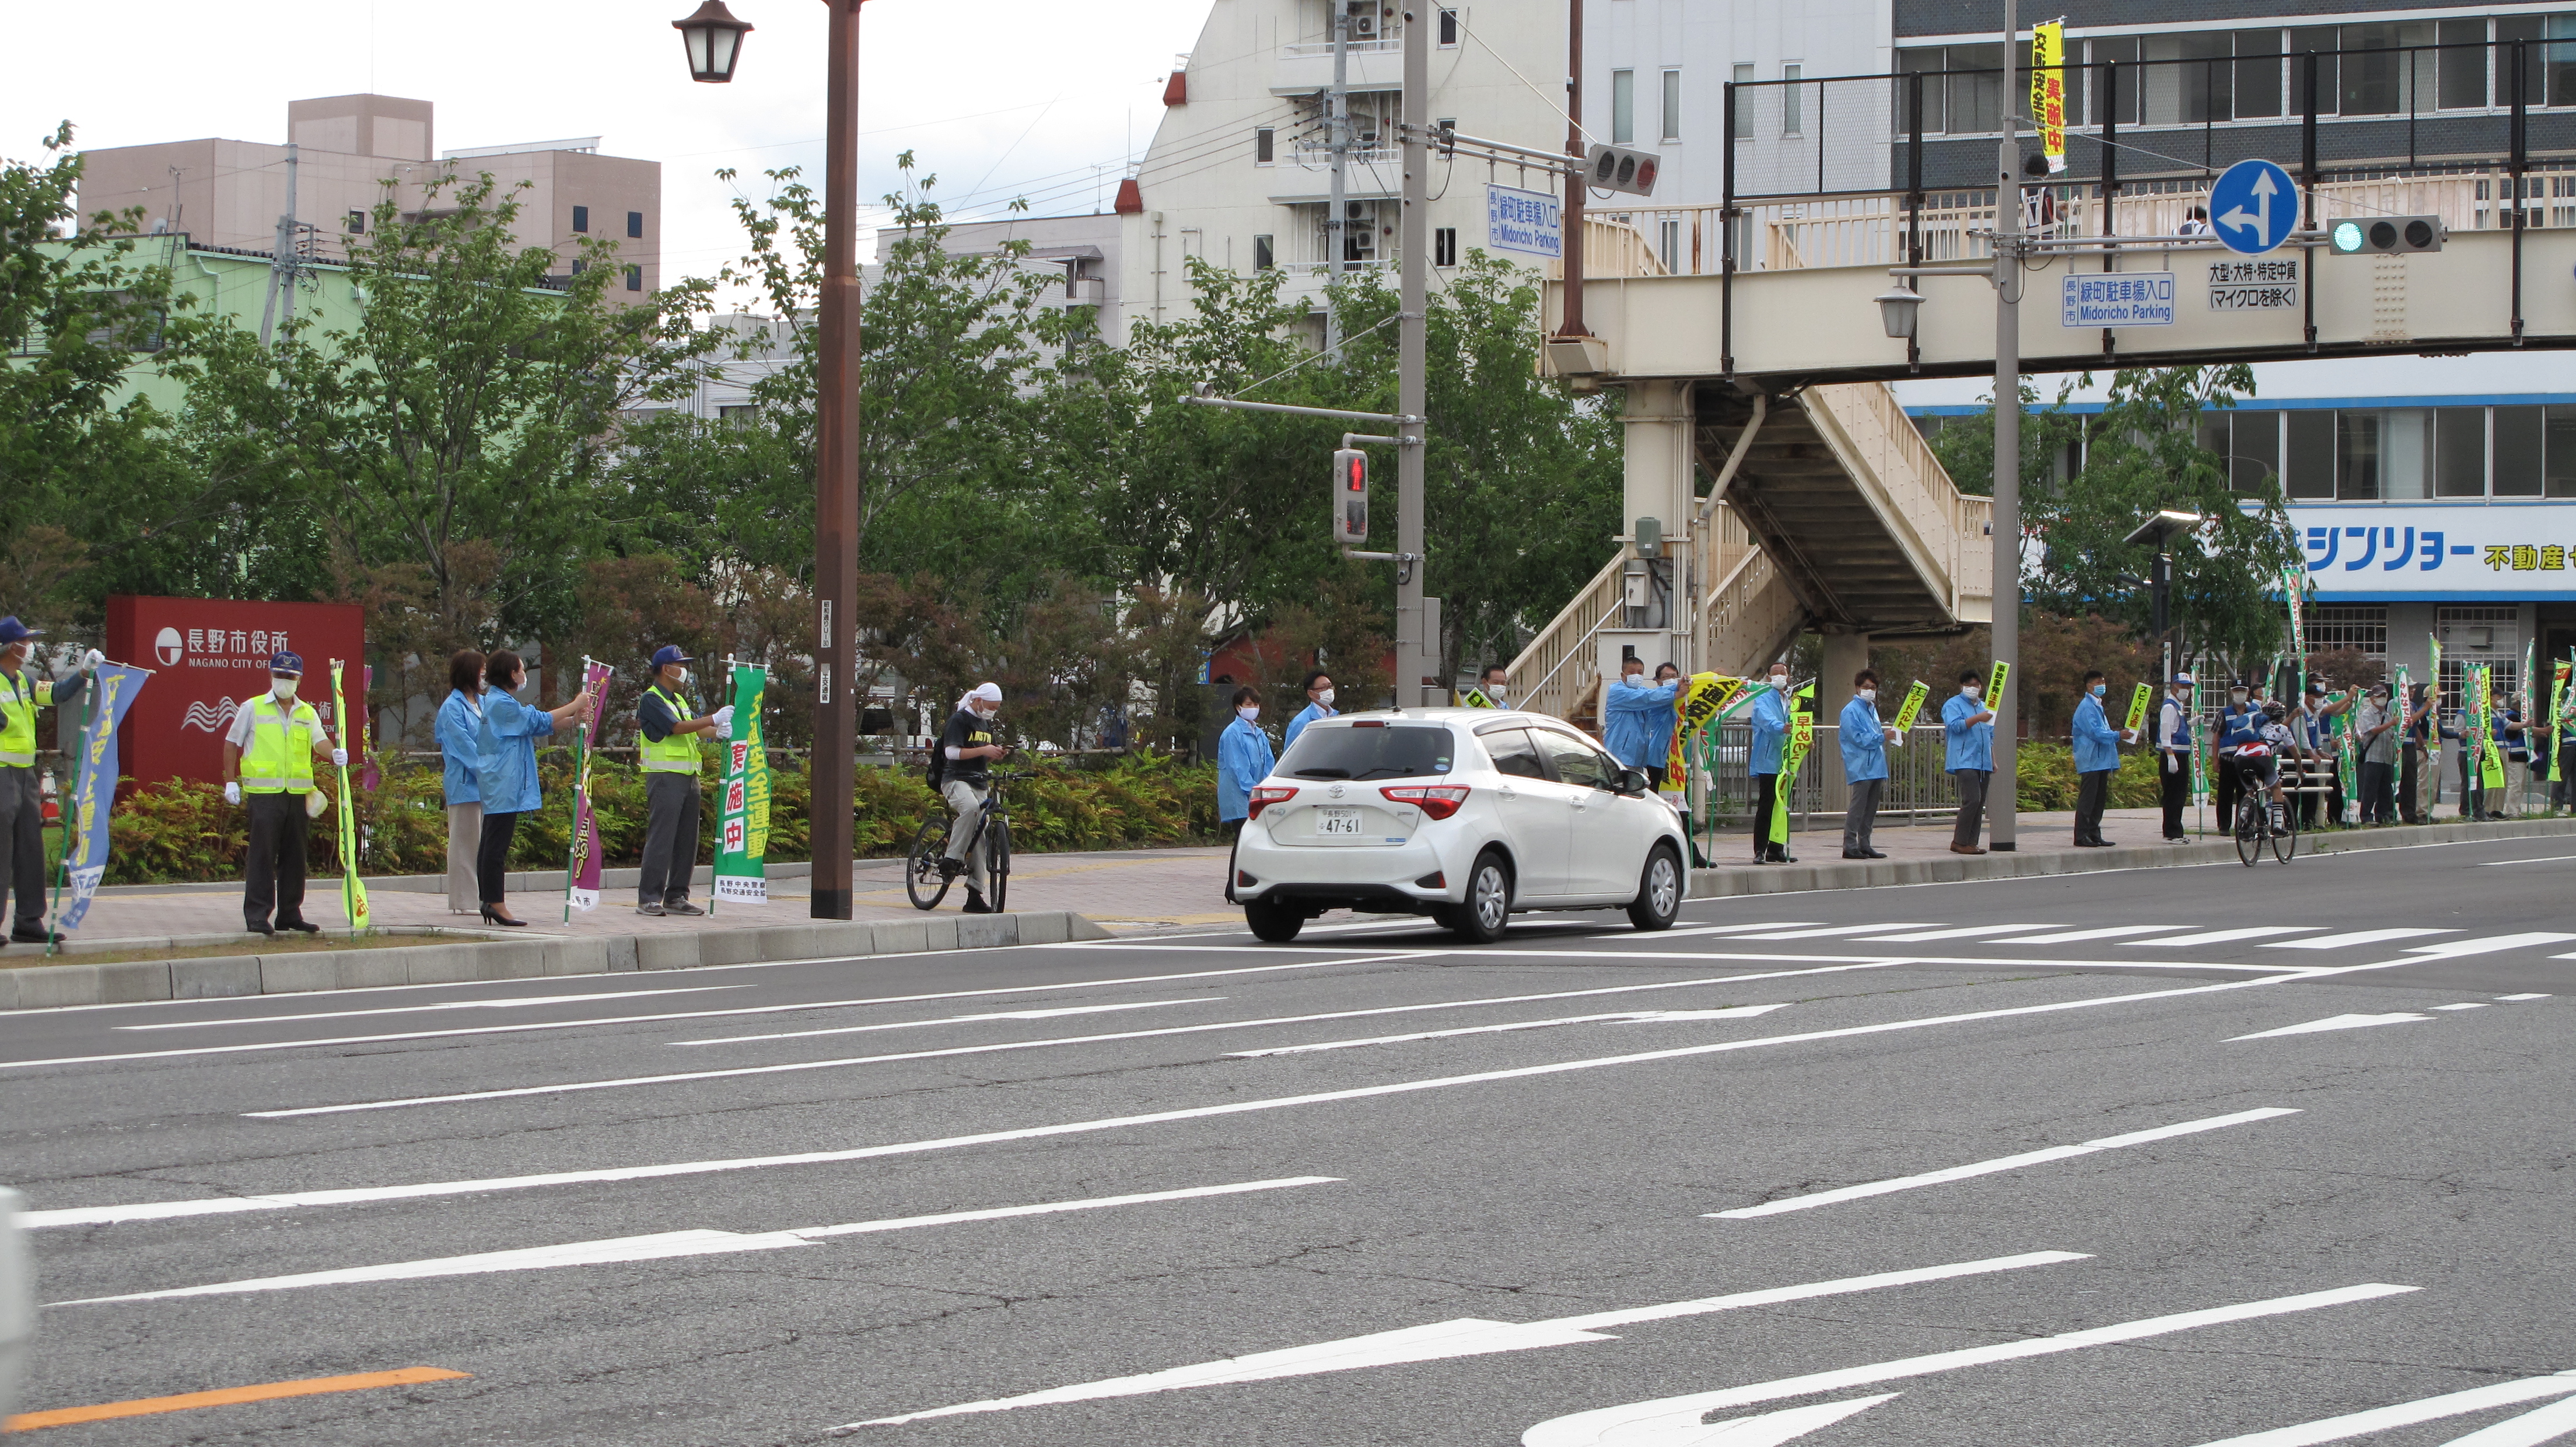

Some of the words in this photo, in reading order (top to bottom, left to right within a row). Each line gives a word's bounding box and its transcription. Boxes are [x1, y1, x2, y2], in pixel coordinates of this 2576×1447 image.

[1490, 191, 1499, 241] 長野市
[1500, 195, 1558, 228] 緑町駐車場入口
[1501, 223, 1533, 245] Midoricho
[1535, 229, 1559, 254] Parking
[2066, 281, 2076, 321] 長野市
[2080, 280, 2171, 302] 緑町駐車場入口
[2210, 288, 2296, 309] (マイクロを除く)
[2080, 305, 2128, 321] Midoricho
[2133, 305, 2171, 322] Parking
[2485, 544, 2576, 571] 不動産
[187, 629, 288, 654] 長野市役所
[189, 658, 229, 668] NAGANO
[232, 660, 252, 669] CITY
[256, 660, 272, 669] OFF
[1898, 695, 1920, 728] シートベルト
[2129, 686, 2147, 728] スピード注意
[2467, 667, 2479, 774] ルールとマナー
[747, 691, 769, 860] 交通安全運動
[726, 743, 746, 849] 実施中
[1326, 819, 1359, 833] 47-61
